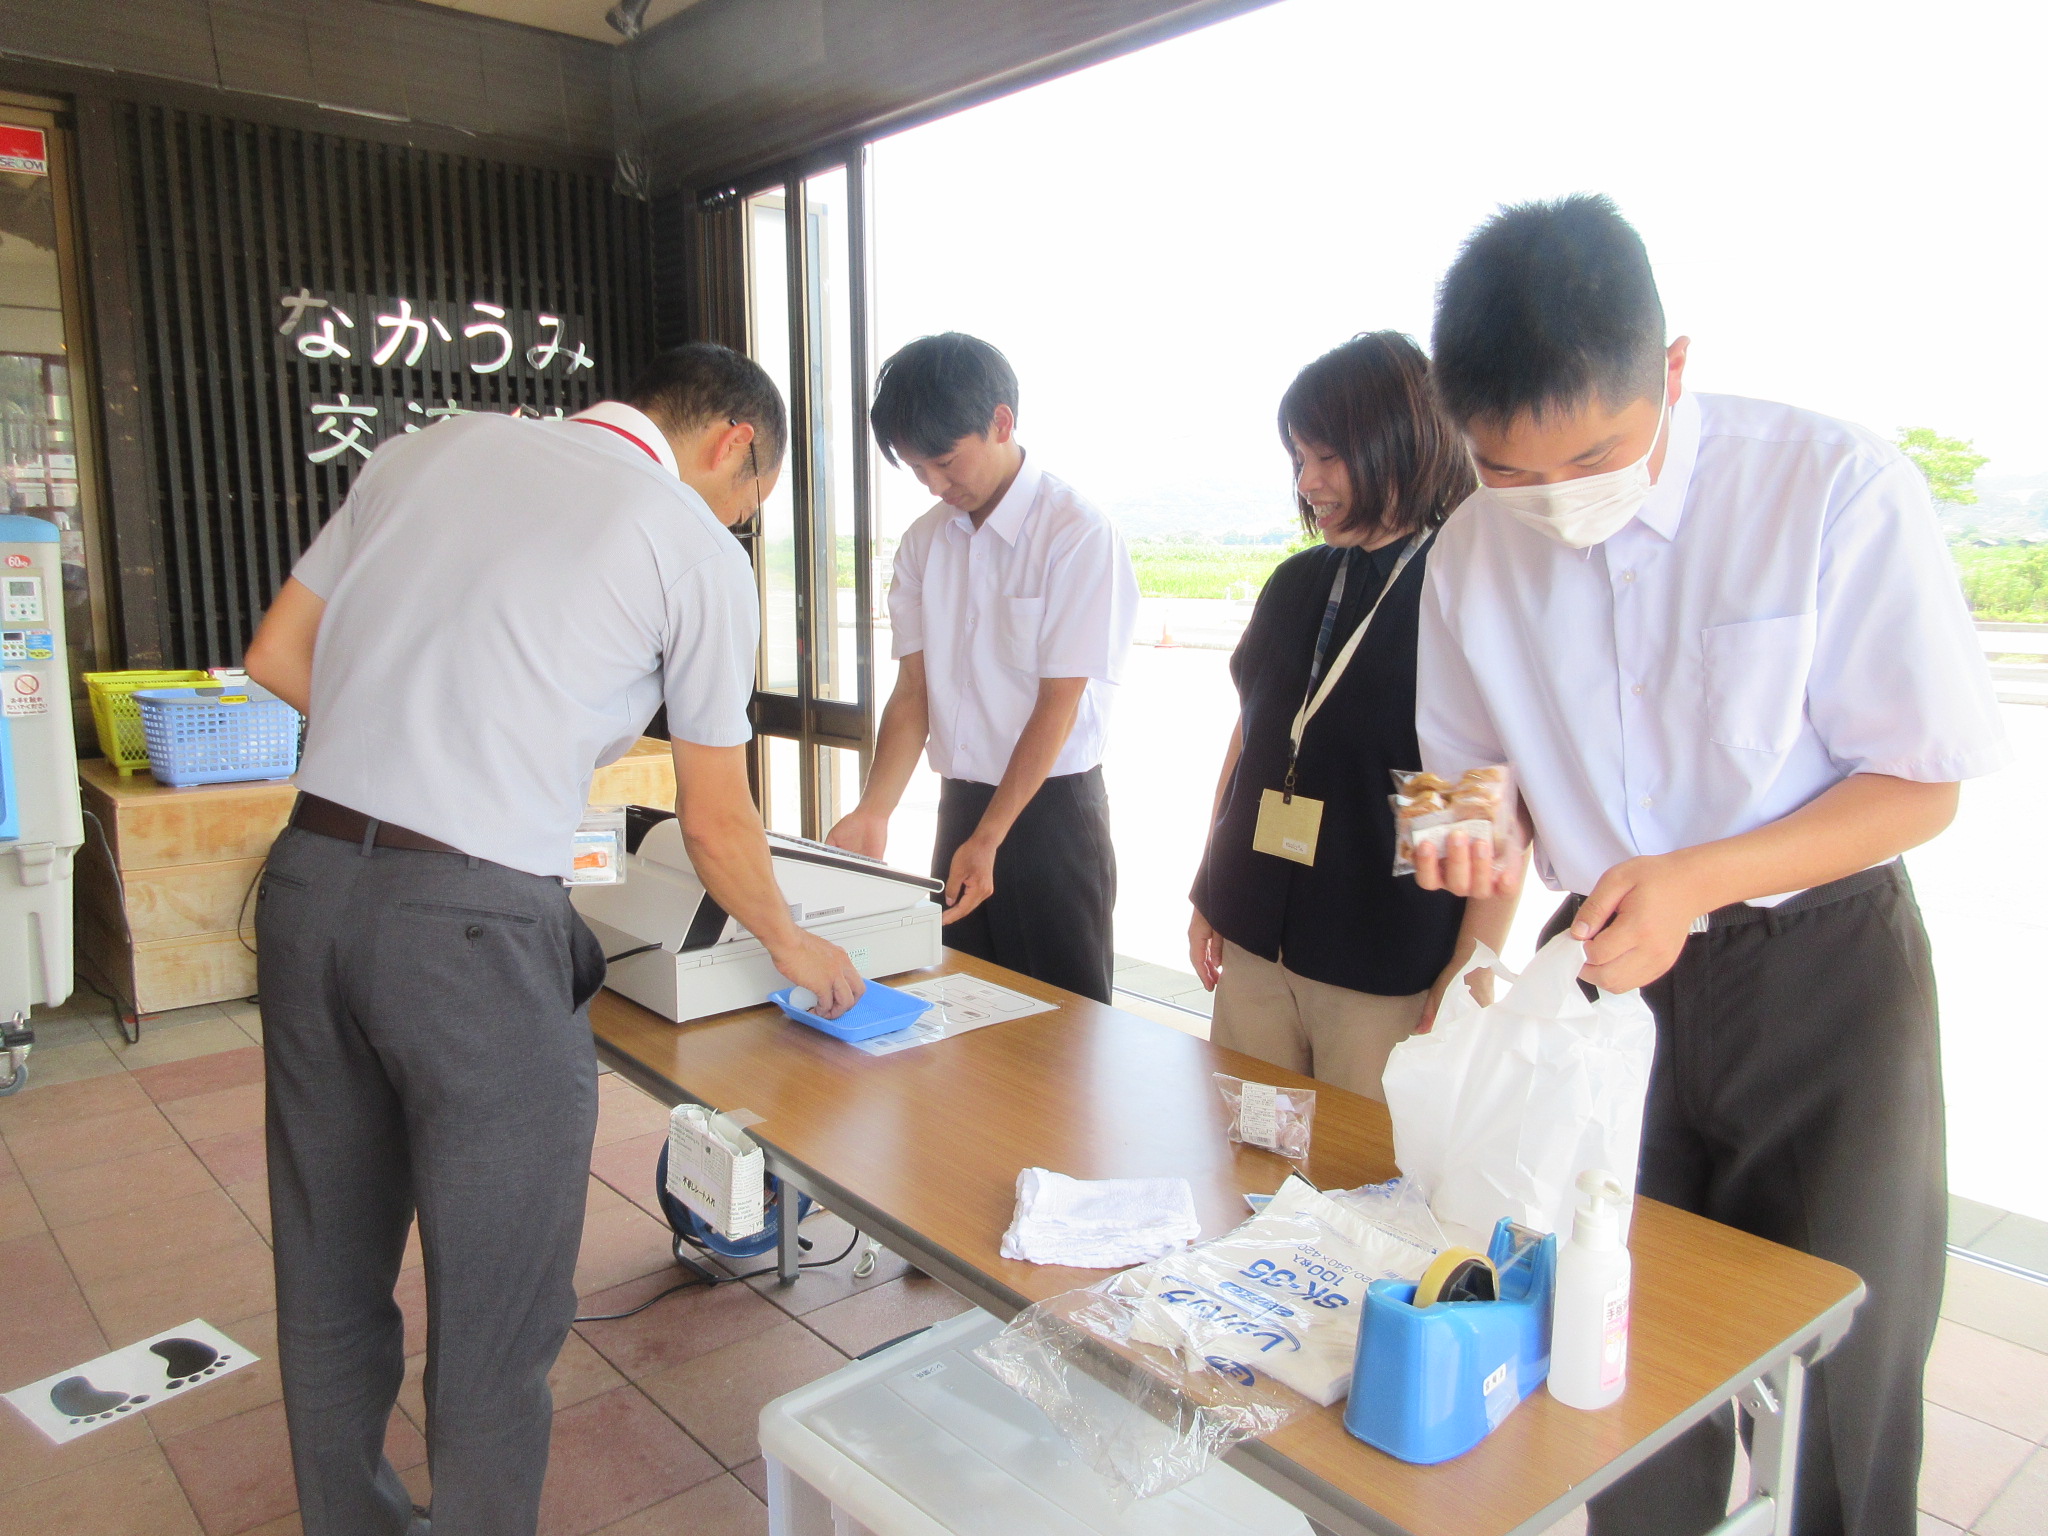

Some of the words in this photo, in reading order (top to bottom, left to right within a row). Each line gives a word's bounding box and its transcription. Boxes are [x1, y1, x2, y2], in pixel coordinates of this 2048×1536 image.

[279, 288, 594, 374] なかうみ
[1238, 1258, 1350, 1310] SK-35
[1158, 1289, 1285, 1353] レジバッグ
